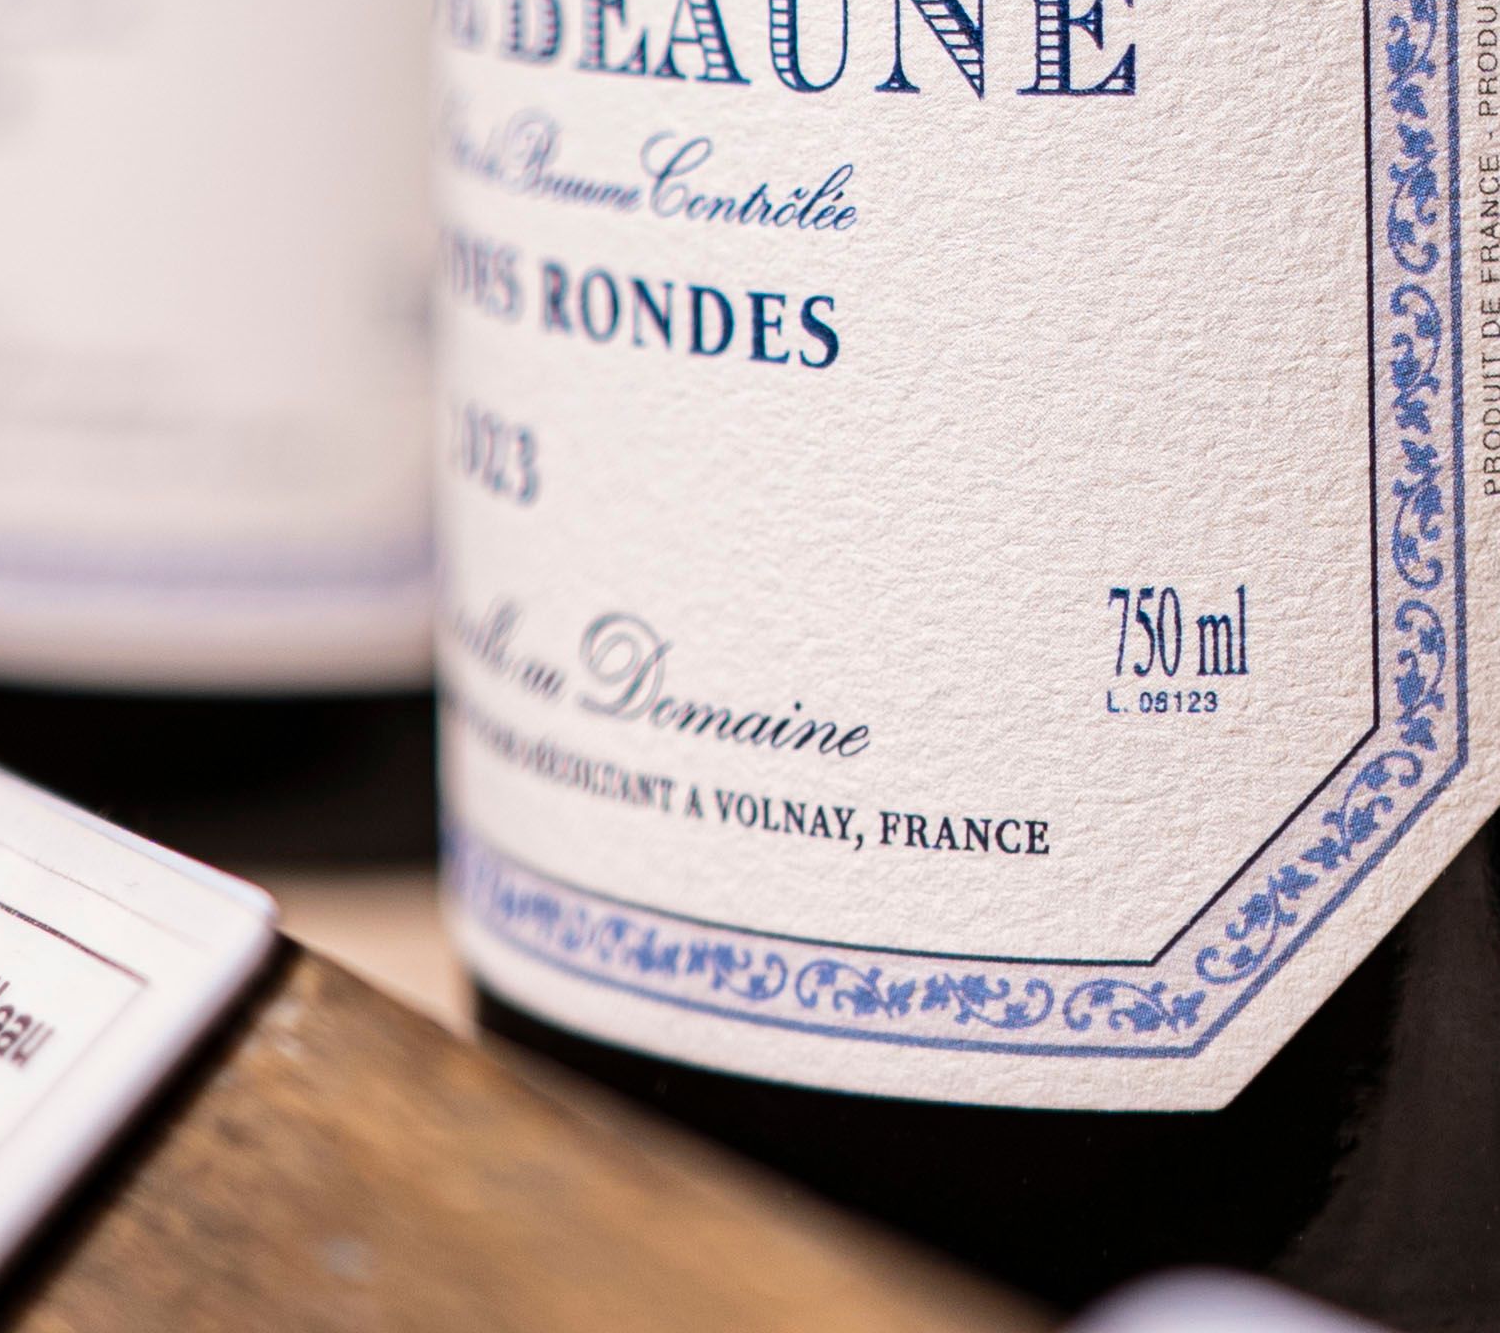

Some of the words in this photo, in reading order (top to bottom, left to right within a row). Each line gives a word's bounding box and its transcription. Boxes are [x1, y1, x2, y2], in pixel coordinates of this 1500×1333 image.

[1478, 153, 1500, 285] FRANCE
[542, 259, 841, 370] RONDES
[575, 612, 871, 758] Domaine
[1107, 586, 1182, 677] 750
[1196, 584, 1249, 677] ml
[683, 785, 704, 820] A
[713, 788, 866, 851] VOLNAY,
[878, 810, 1051, 856] FRANCE
